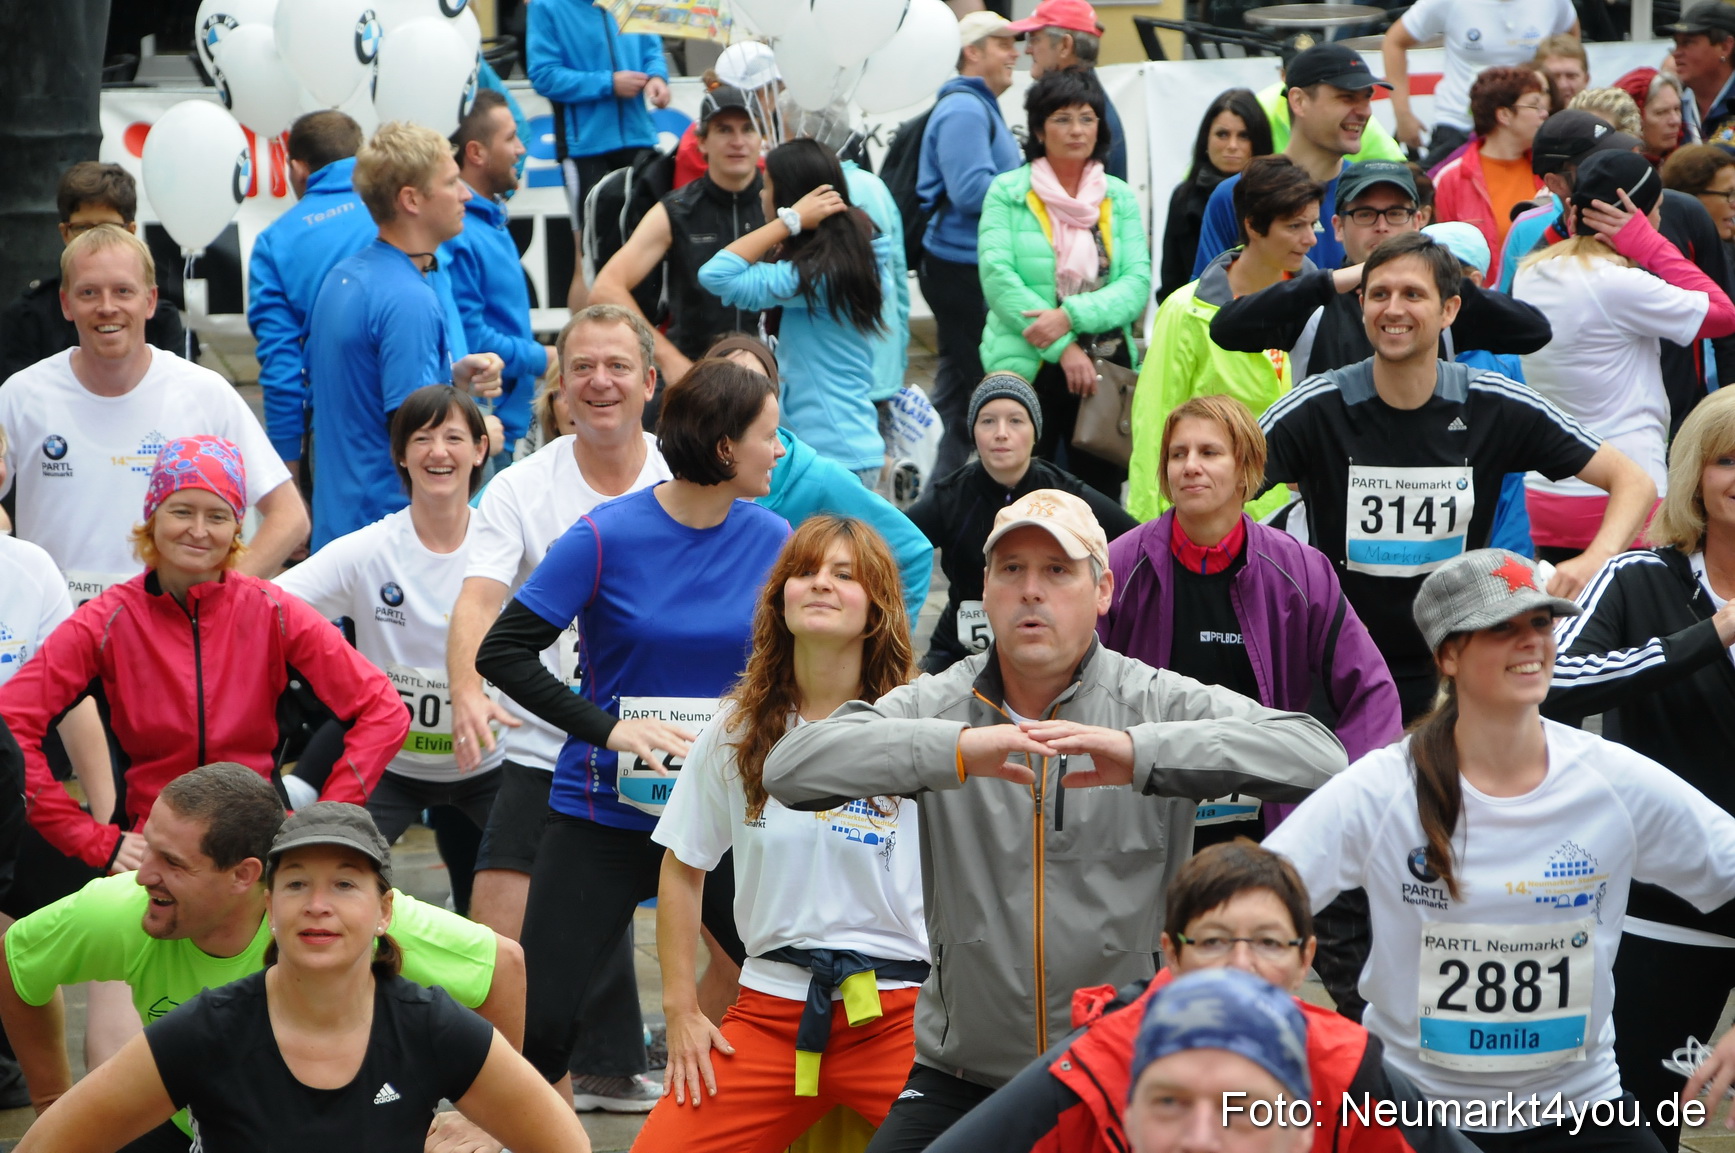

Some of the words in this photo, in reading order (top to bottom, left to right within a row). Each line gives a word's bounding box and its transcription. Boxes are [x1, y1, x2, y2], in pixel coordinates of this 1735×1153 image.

[303, 202, 355, 226] Team
[41, 462, 73, 471] PARTL
[1351, 478, 1392, 490] PARTL
[1395, 480, 1452, 490] Neumarkt
[1361, 495, 1457, 535] 3141
[375, 615, 406, 627] Neumarkt
[376, 606, 406, 621] PARTL
[1210, 631, 1246, 645] PFLEIDE
[387, 671, 424, 688] PARTL
[623, 709, 666, 721] PARTL
[1402, 883, 1449, 901] PARTL
[1505, 880, 1532, 896] 14.
[1403, 897, 1448, 911] Neumarkt
[1425, 935, 1482, 952] PARTL
[1487, 938, 1565, 952] Neumarkt
[1437, 956, 1570, 1014] 2881
[1469, 1029, 1540, 1050] Danila
